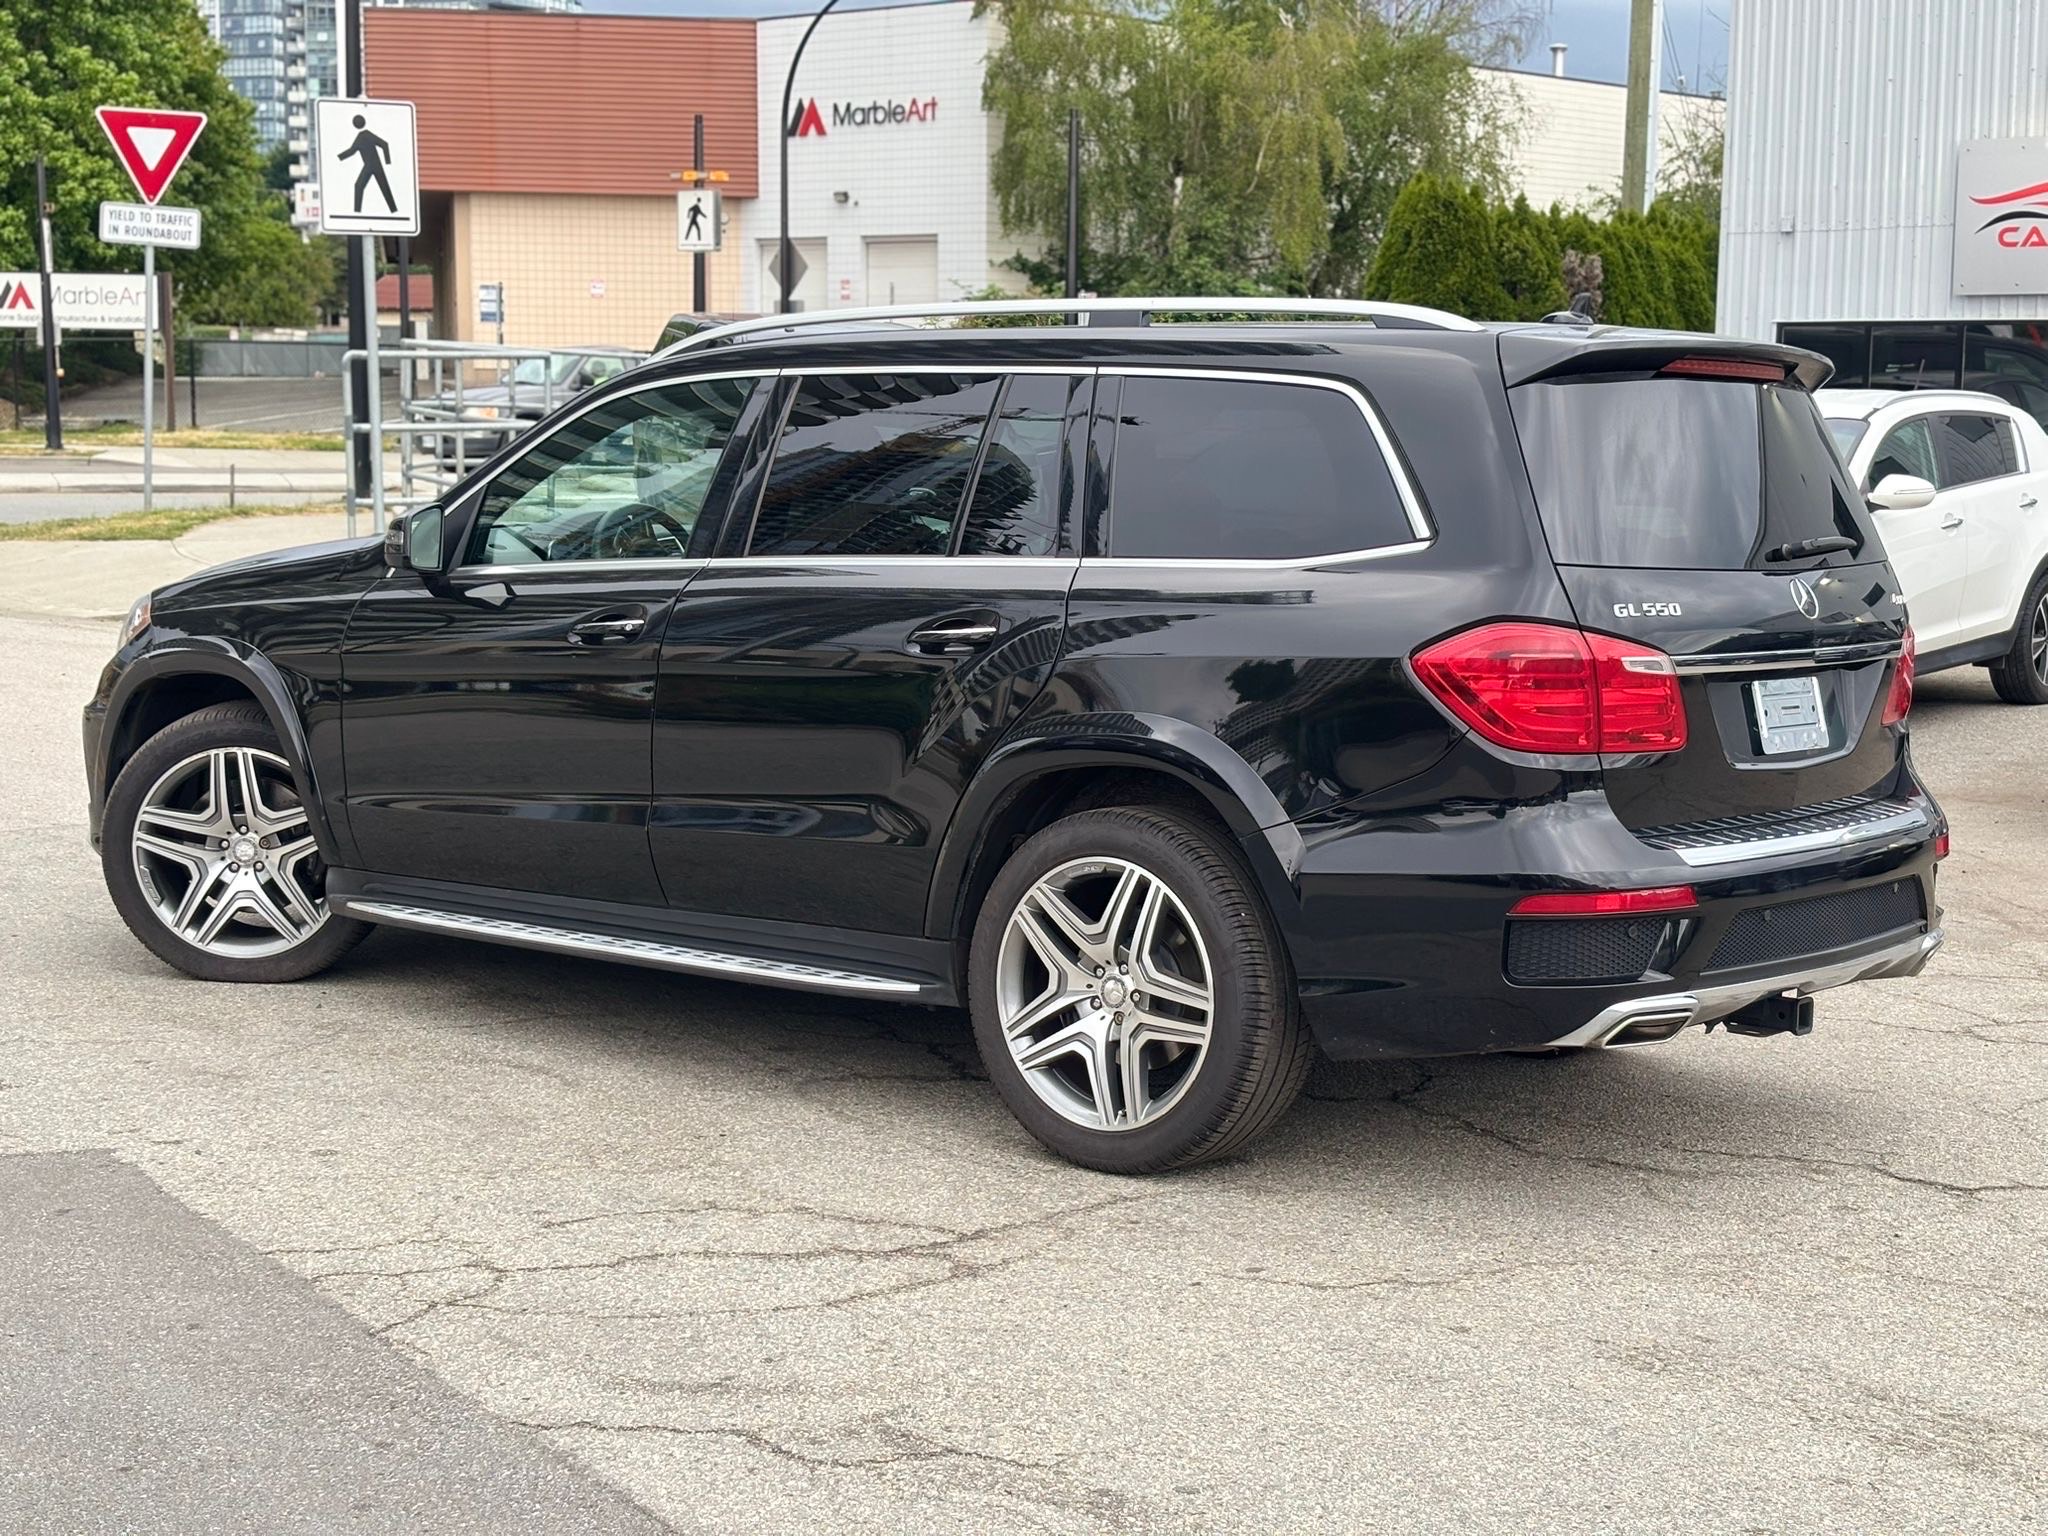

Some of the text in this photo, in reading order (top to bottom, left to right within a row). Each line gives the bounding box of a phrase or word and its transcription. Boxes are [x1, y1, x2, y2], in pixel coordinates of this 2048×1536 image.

[832, 96, 938, 127] MarbleArt
[108, 209, 193, 227] YIELD TO TRAFFIC
[108, 224, 192, 242] IN ROUNDABOUT
[1613, 602, 1682, 618] GL 550
